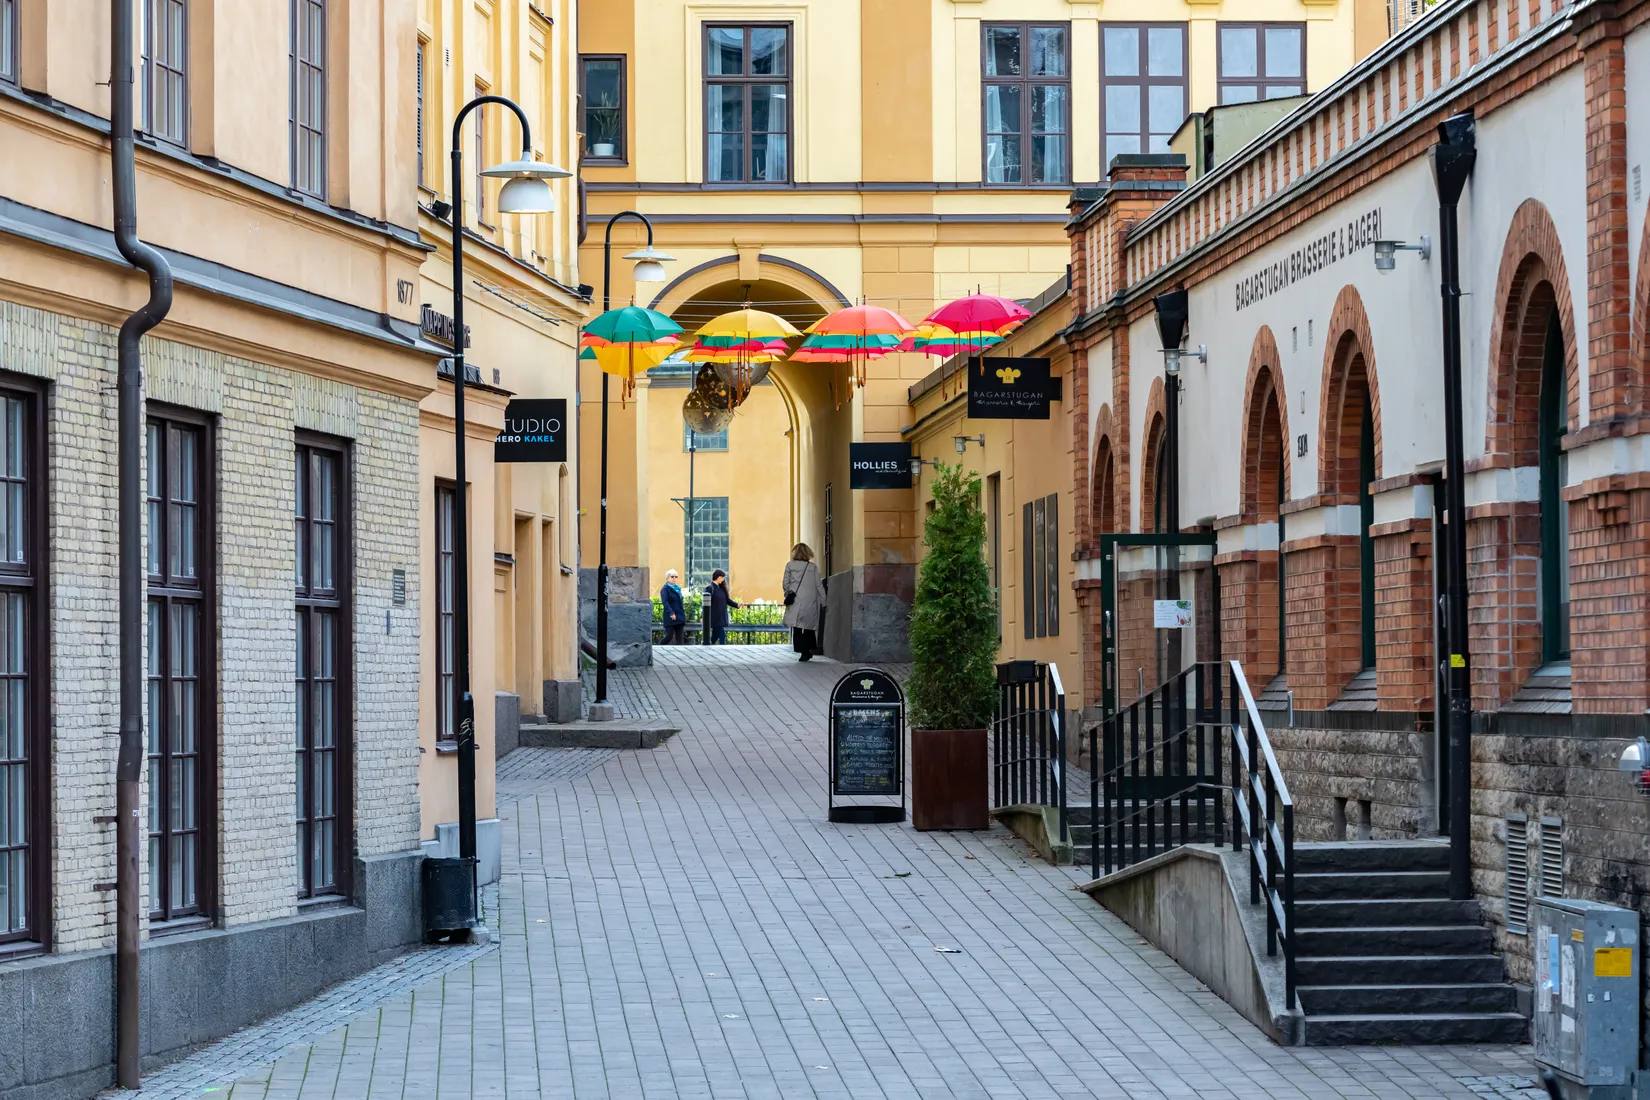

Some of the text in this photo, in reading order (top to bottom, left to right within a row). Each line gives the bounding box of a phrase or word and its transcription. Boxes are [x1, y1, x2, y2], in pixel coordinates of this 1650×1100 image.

[1235, 206, 1382, 312] BAGARSTUGAN BRASSERIE & BAGERI
[396, 278, 414, 306] 1877
[973, 391, 1043, 399] BAGARSTUGAN
[524, 435, 555, 443] KAKEL
[853, 461, 898, 470] HOLLIES
